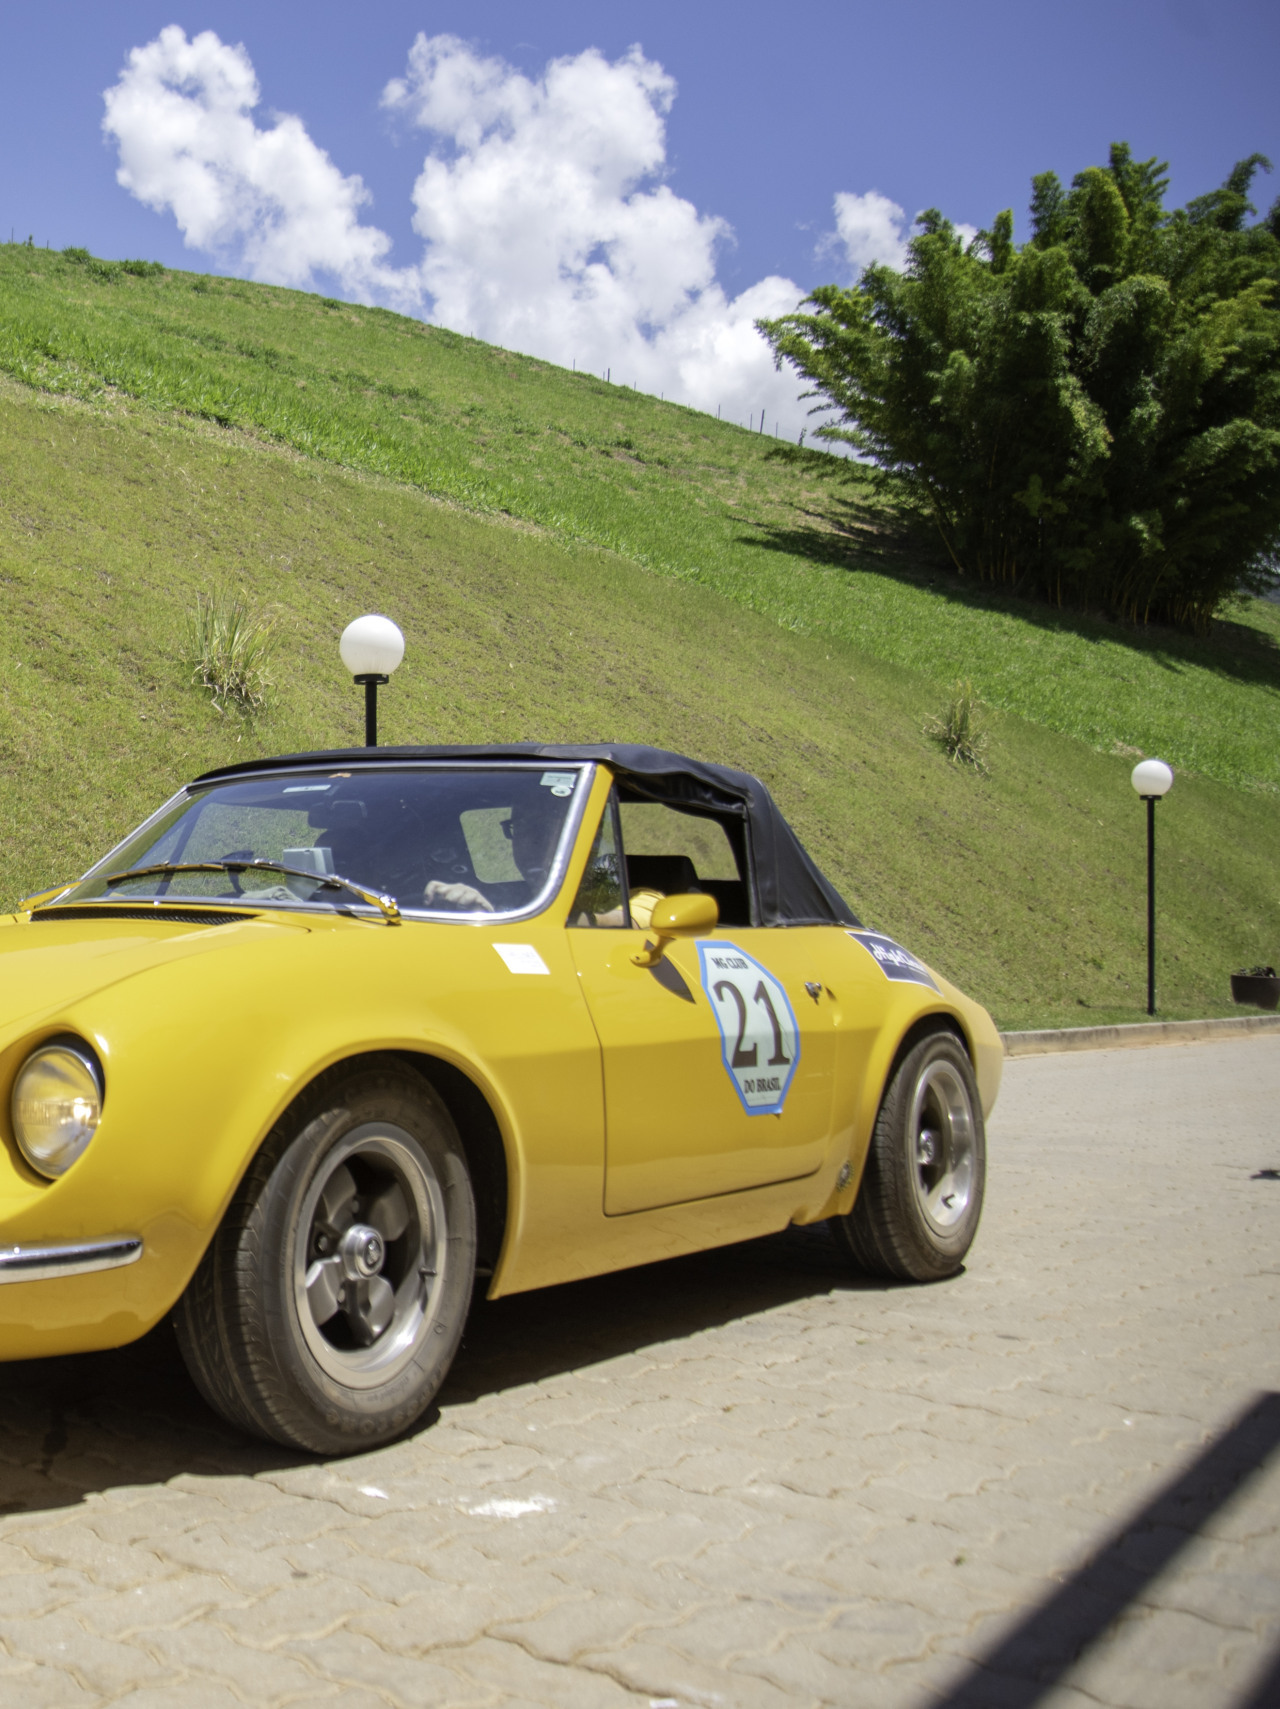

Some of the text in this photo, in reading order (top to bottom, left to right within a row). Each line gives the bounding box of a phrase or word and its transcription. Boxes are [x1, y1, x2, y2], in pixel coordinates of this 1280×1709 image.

[711, 957, 749, 970] MG CLUB
[713, 980, 791, 1070] 21
[744, 1077, 782, 1094] DO BRASIL
